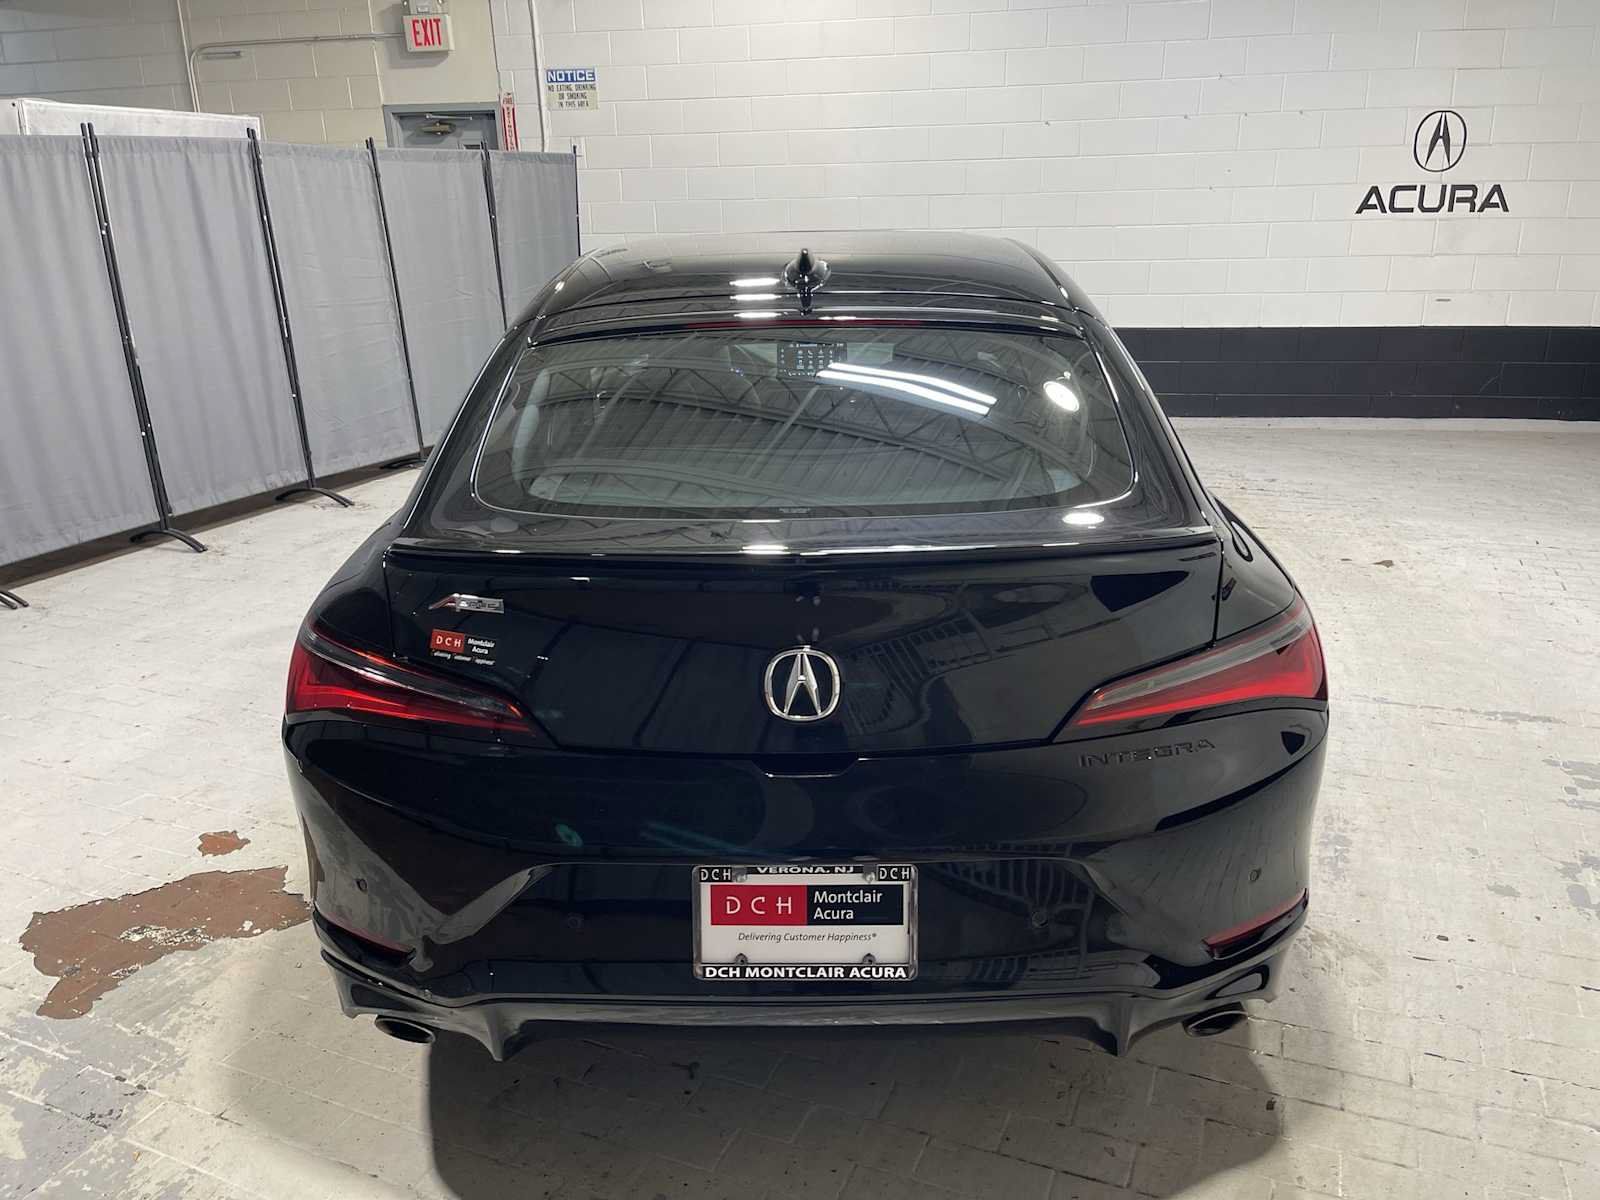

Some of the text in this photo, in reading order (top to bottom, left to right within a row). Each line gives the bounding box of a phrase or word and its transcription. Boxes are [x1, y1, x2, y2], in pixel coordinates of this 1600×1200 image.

[412, 18, 442, 47] EXIT
[547, 70, 595, 82] NOTICE
[1355, 184, 1510, 214] ACURA
[436, 635, 461, 647] DCH
[471, 646, 489, 655] Acura
[1078, 739, 1216, 767] INTEGRA
[700, 868, 732, 881] DCH
[834, 865, 855, 874] NJ
[880, 867, 910, 881] DCH
[813, 889, 883, 904] Montclair
[813, 906, 854, 920] Acura
[738, 932, 782, 943] Delivering
[783, 932, 826, 942] Customer
[705, 966, 907, 979] DCH MONTCLAIR ACURA
